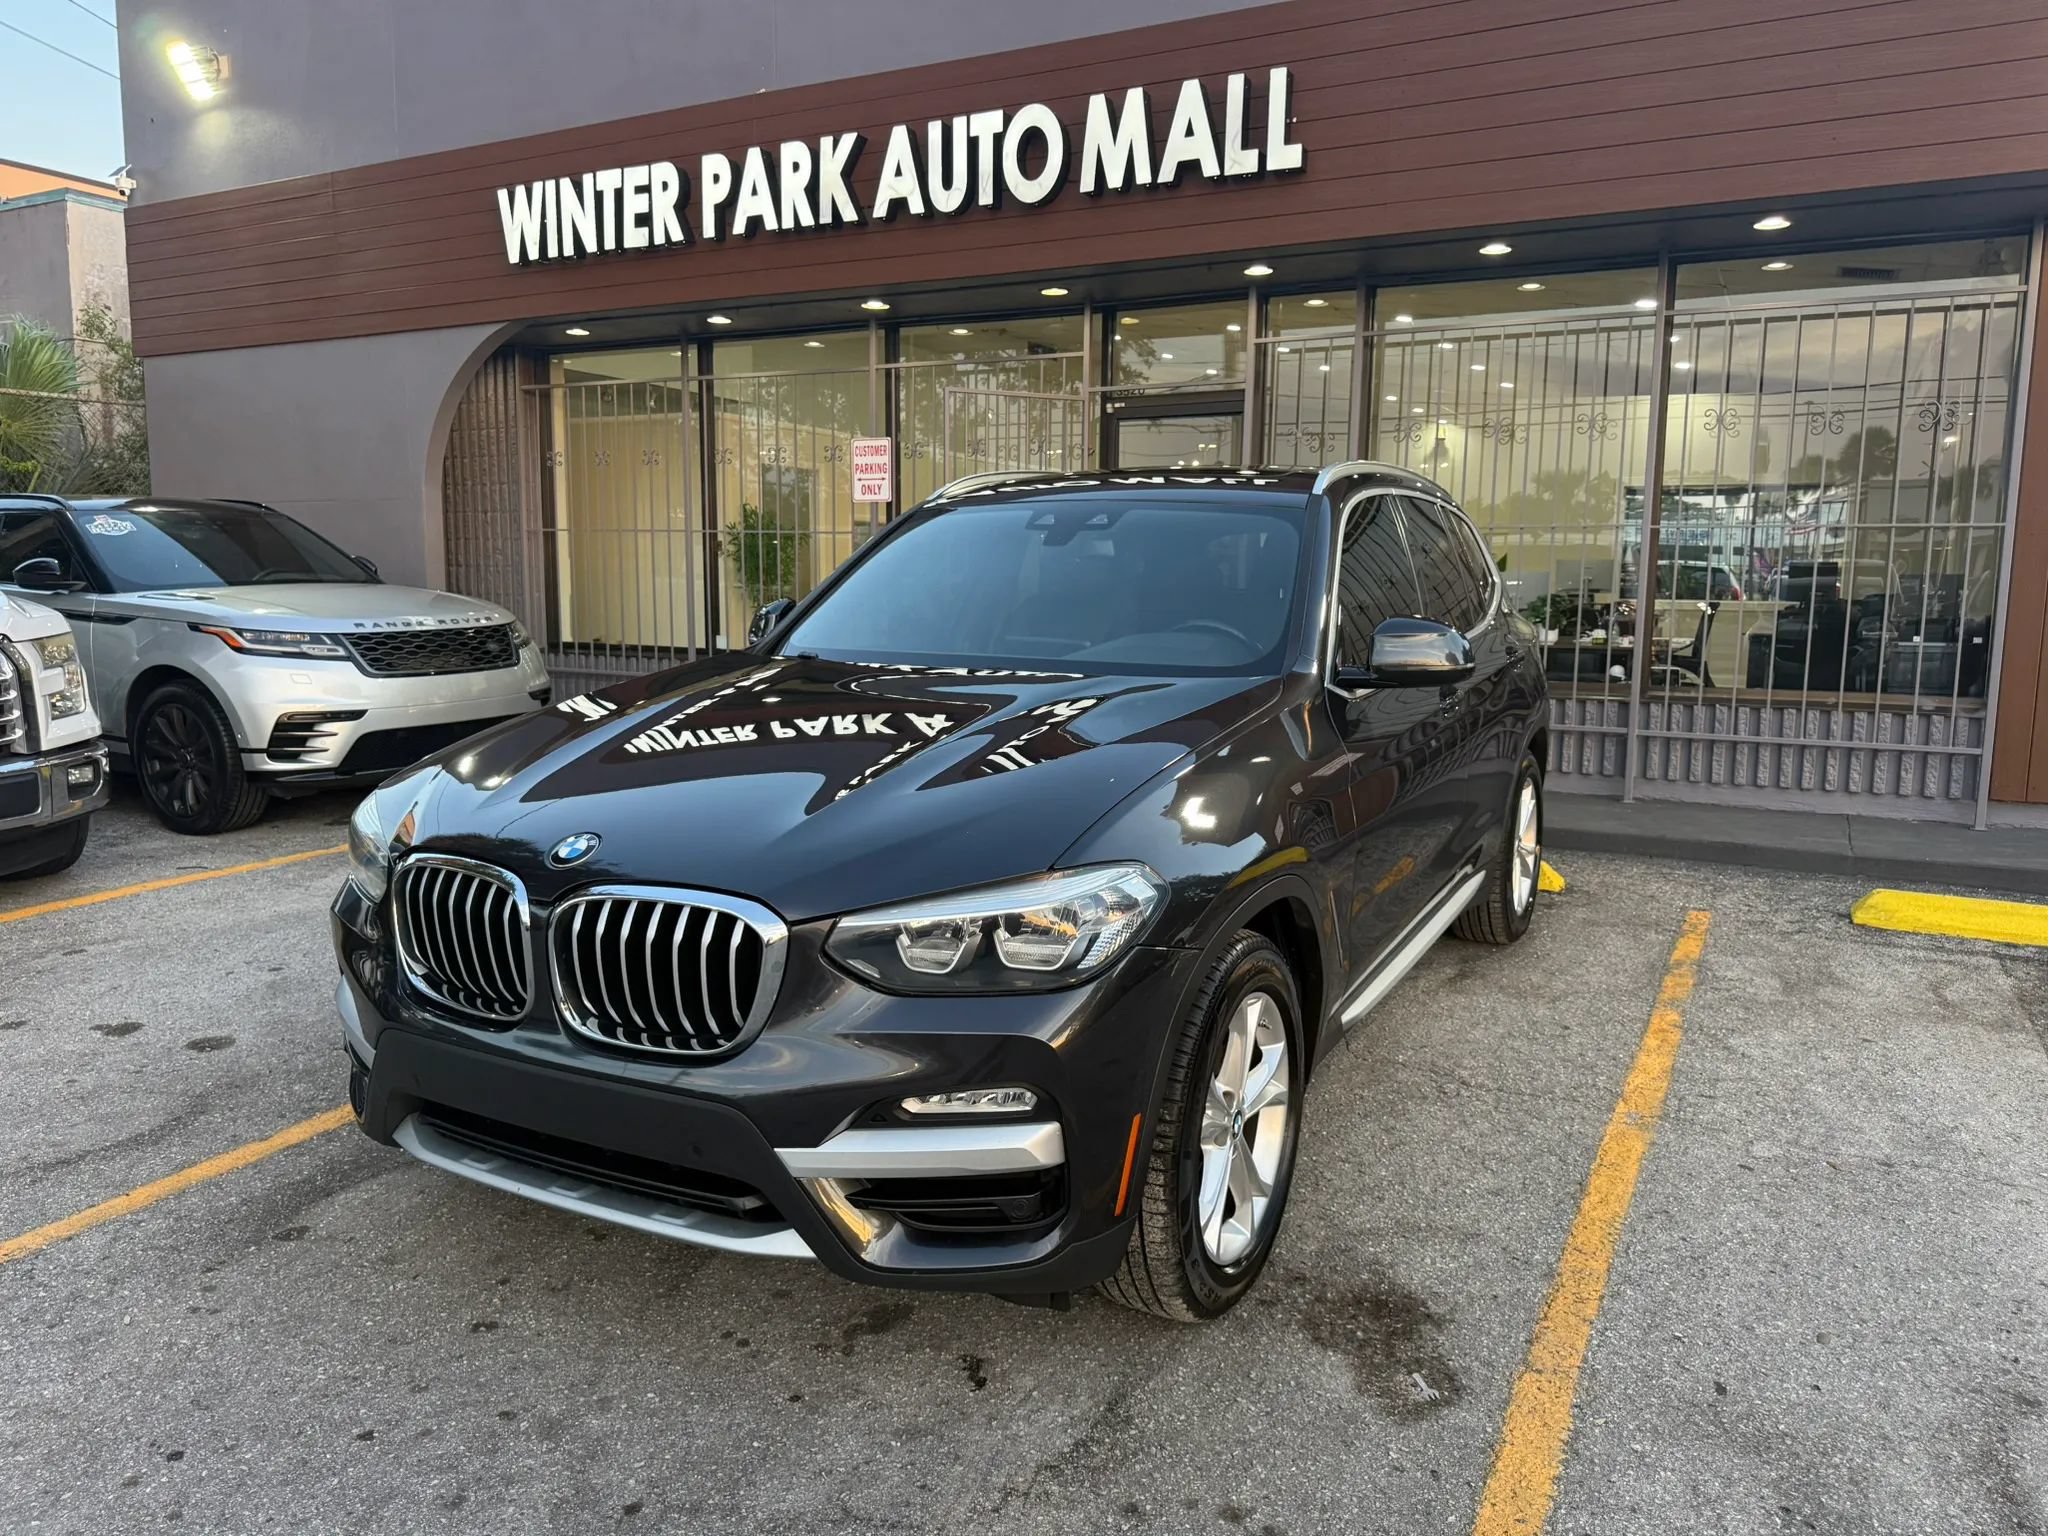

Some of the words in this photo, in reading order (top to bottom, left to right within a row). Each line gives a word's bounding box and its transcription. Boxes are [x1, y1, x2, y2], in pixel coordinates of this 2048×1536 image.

[497, 161, 685, 264] WINTER
[701, 132, 860, 240] PARK
[872, 103, 1065, 220] AUTO
[1079, 66, 1304, 193] MALL
[854, 444, 888, 457] CUSTOMER
[854, 462, 888, 475] PARKING
[860, 483, 883, 496] ONLY
[352, 620, 426, 629] RANGE
[437, 615, 493, 626] ROVER
